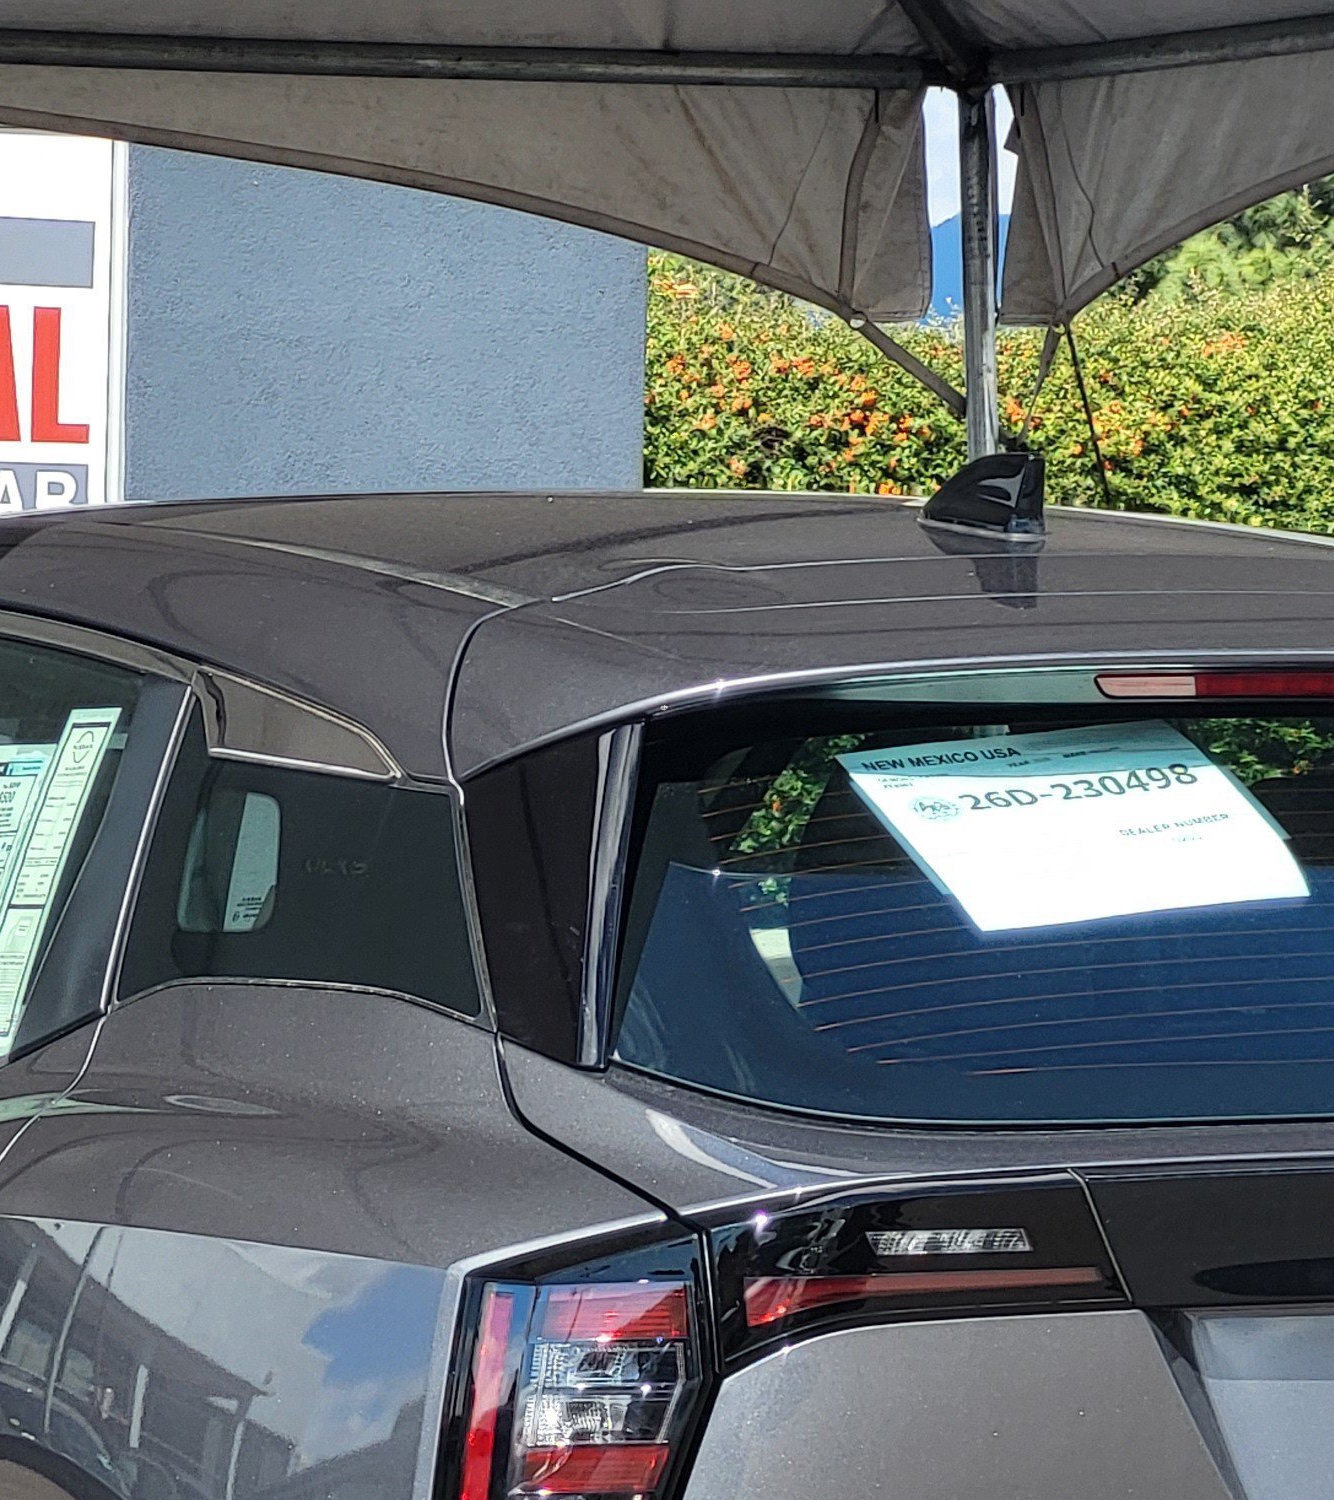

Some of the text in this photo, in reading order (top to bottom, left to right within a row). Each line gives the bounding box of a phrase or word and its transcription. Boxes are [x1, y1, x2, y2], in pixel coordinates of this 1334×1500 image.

[861, 757, 906, 772] NEW
[907, 751, 979, 768] MEXICO
[980, 747, 1022, 760] USA
[958, 763, 1198, 810] 26D-230498
[1118, 812, 1230, 837] DEALER NUMBER
